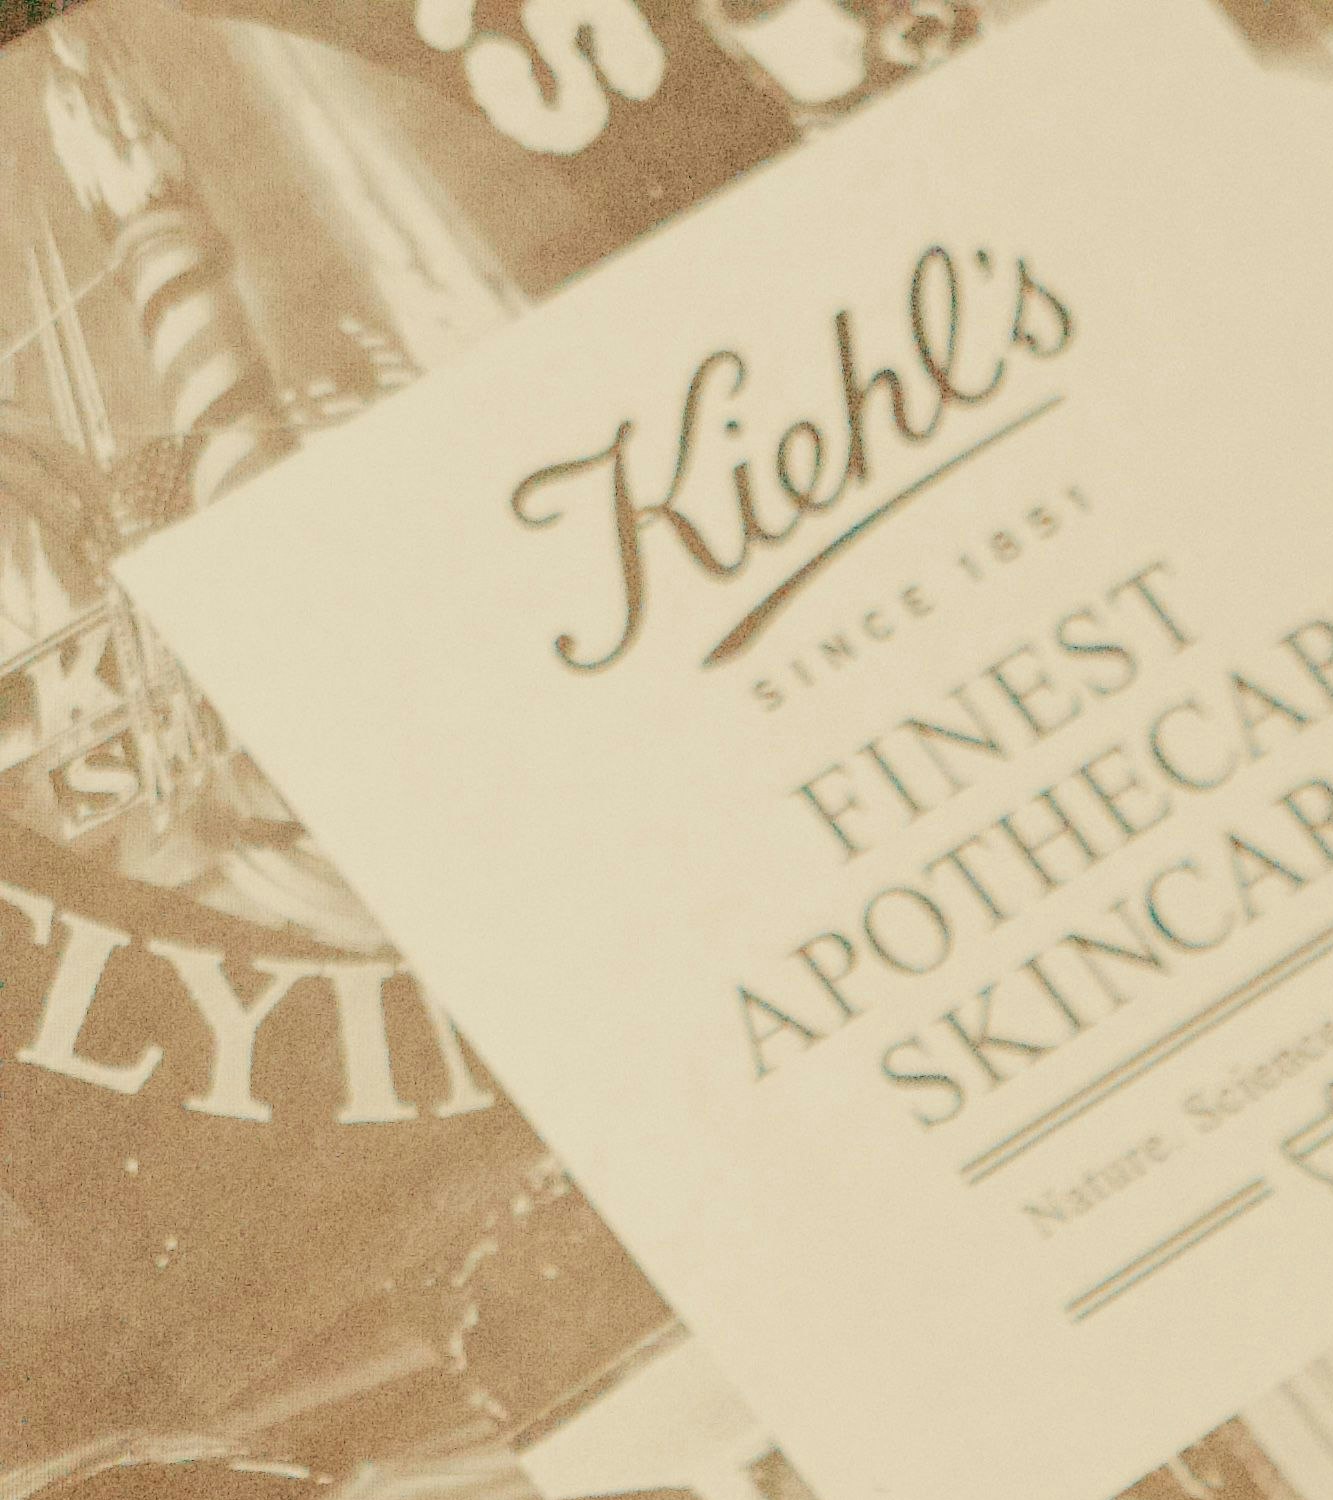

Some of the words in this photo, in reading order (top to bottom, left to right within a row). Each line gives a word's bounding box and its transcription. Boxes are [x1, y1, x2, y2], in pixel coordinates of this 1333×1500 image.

[510, 244, 1074, 673] Kiehl's
[752, 585, 935, 713] SINCE
[960, 485, 1095, 583] 1851
[795, 560, 1198, 864] FINEST
